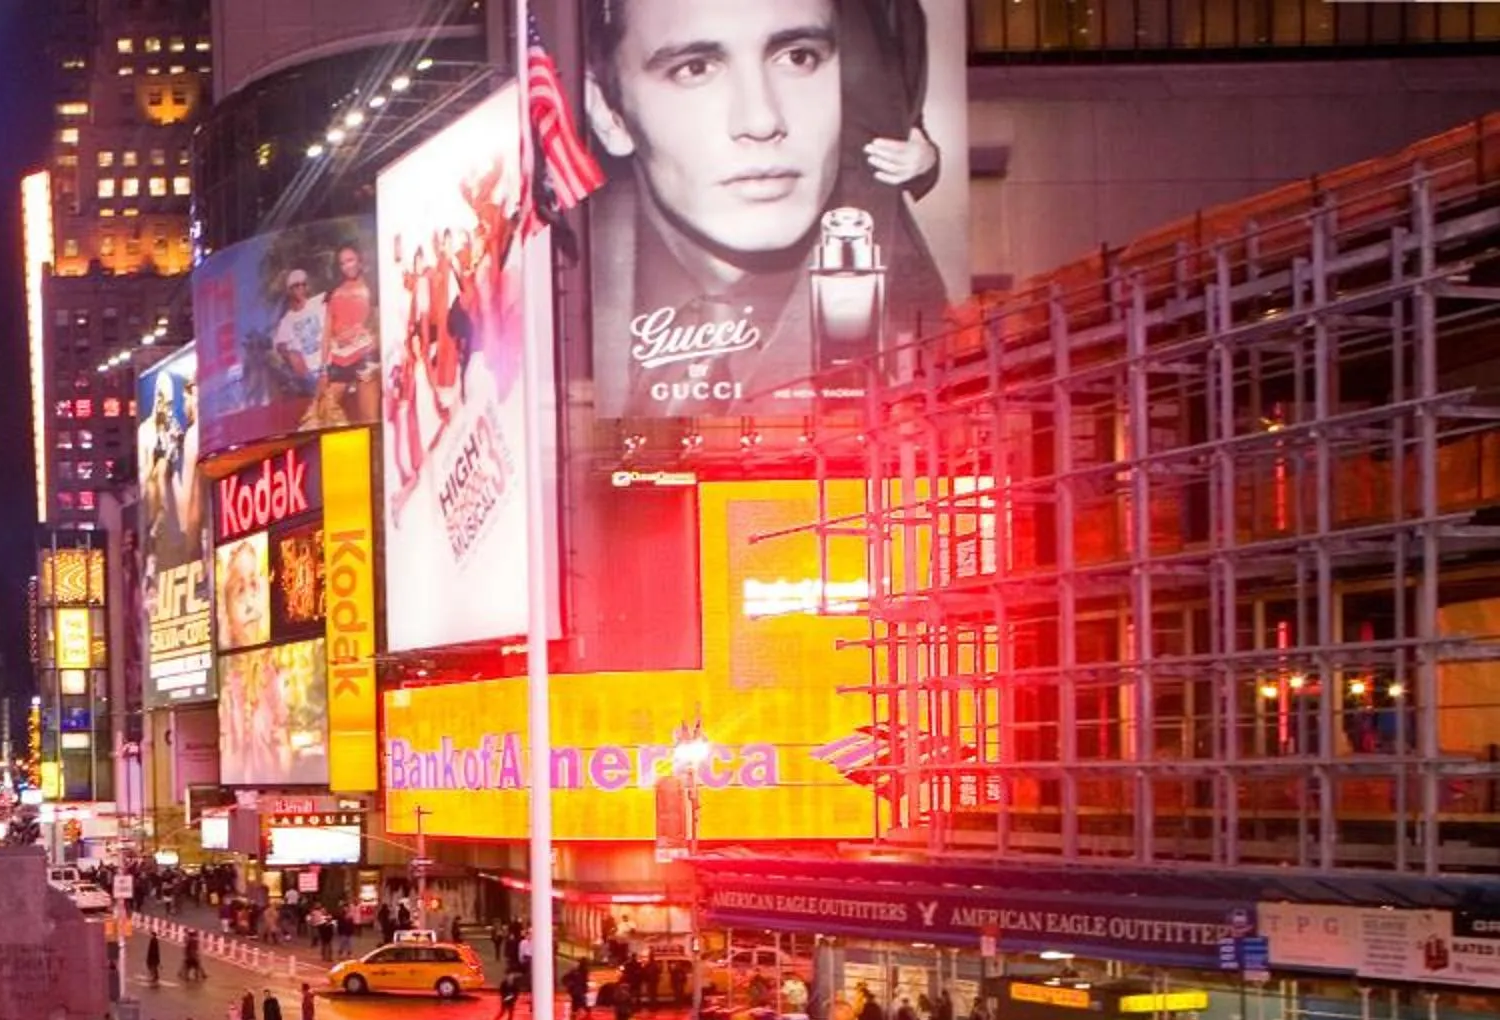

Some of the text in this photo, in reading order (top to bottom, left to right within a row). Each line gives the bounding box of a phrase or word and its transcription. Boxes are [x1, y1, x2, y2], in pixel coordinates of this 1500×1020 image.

[630, 305, 759, 366] Gucci
[651, 381, 743, 401] GUCCI
[220, 449, 309, 537] Kodak
[440, 433, 480, 517] HIGH
[156, 559, 211, 618] UFC
[329, 529, 369, 697] Kodak
[391, 732, 778, 789] Bank of Amerca
[713, 890, 908, 922] AMERICAN EAGLE OUTFITTERS
[951, 906, 1238, 946] AMERICAN EAGLE OUTFITTER
